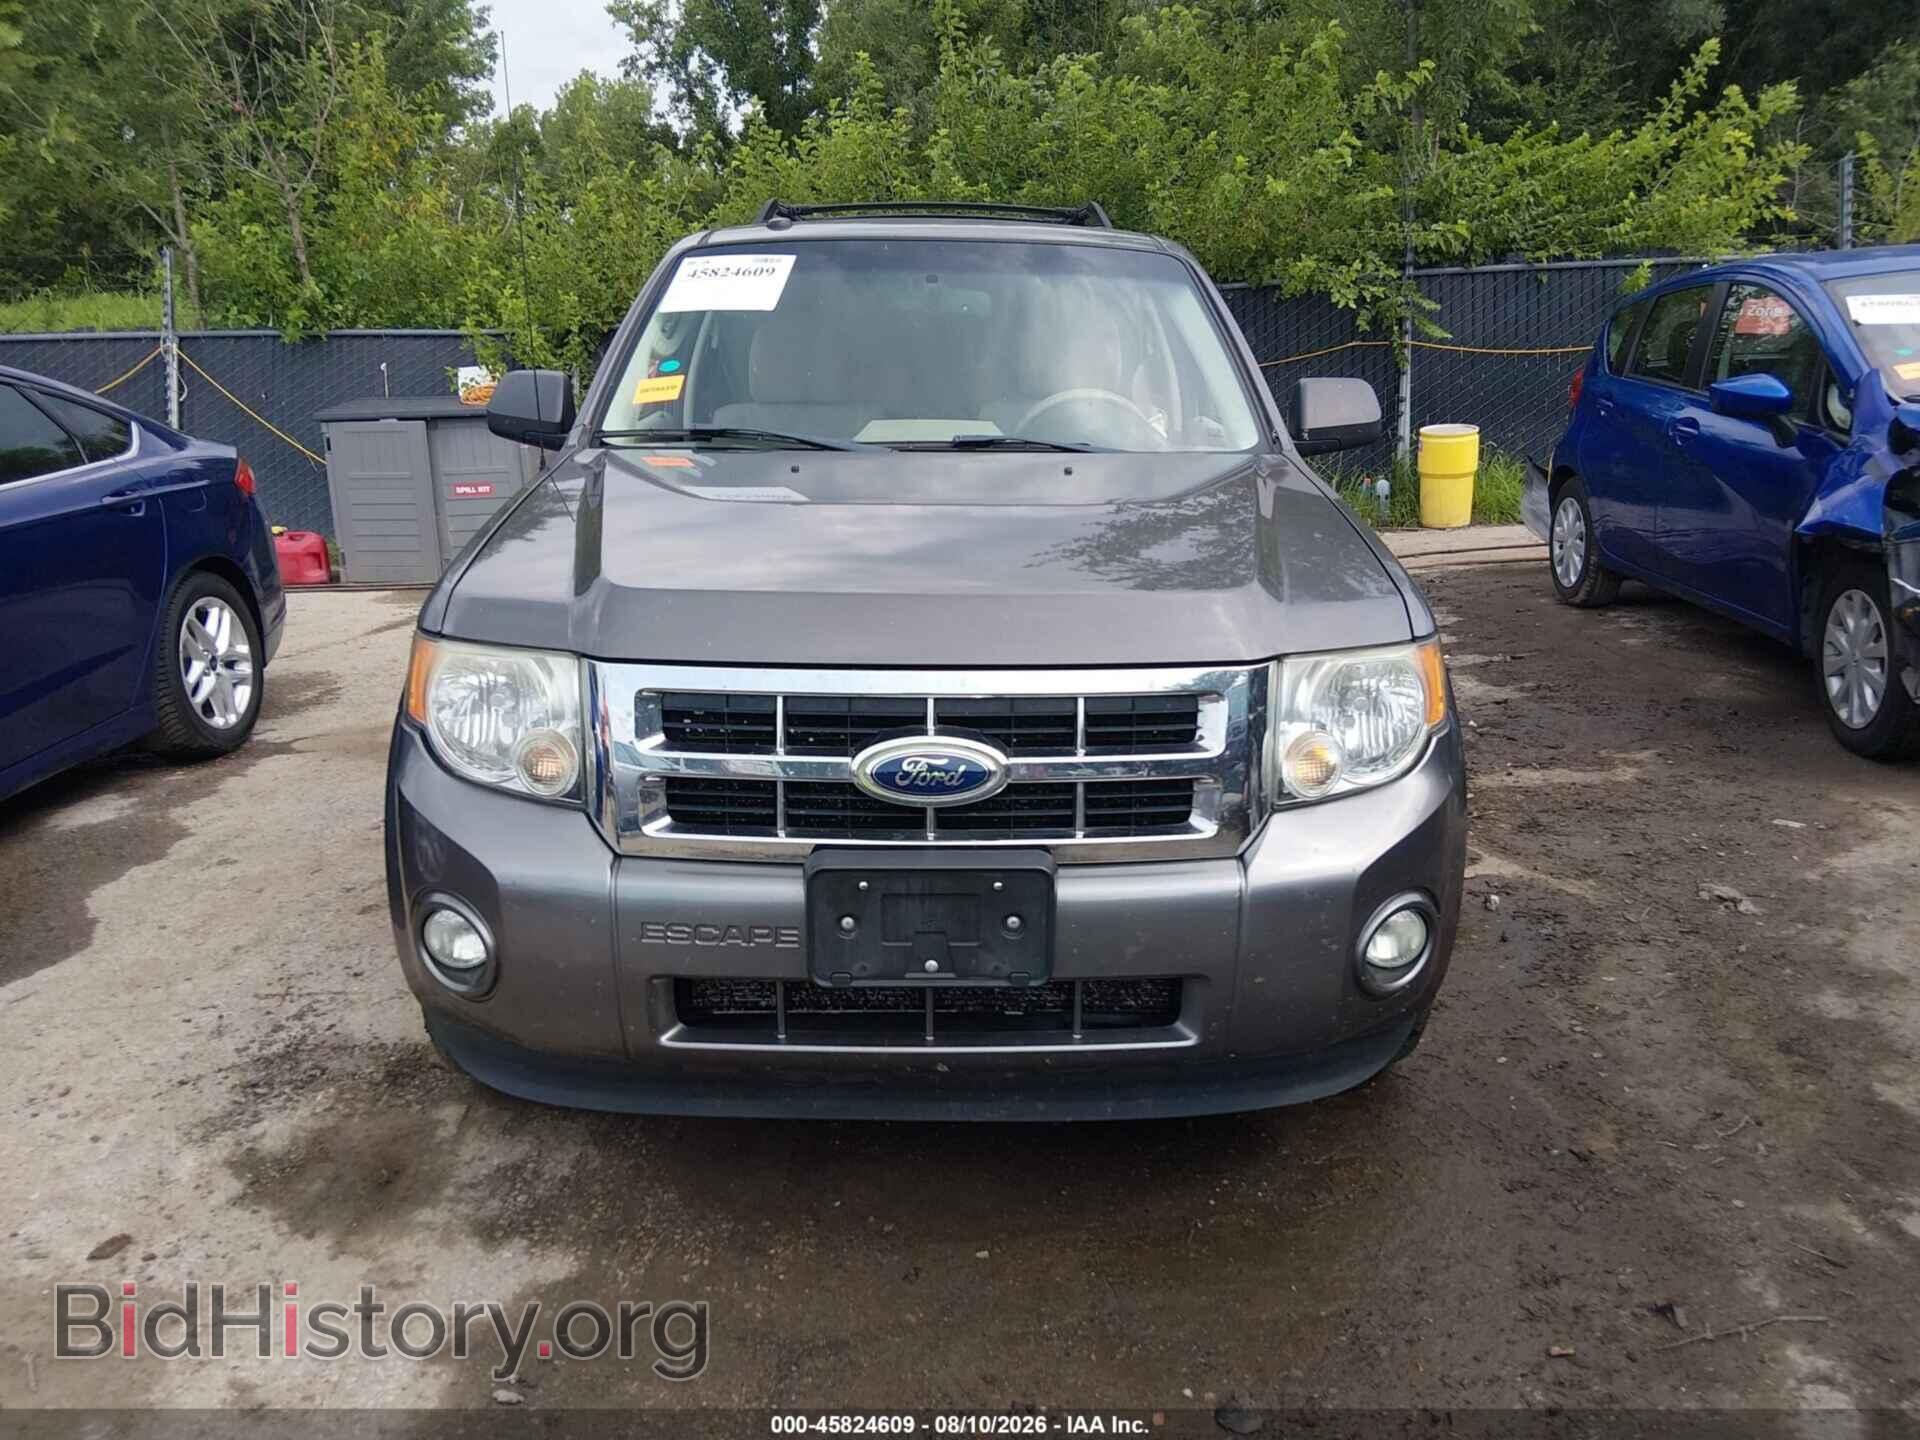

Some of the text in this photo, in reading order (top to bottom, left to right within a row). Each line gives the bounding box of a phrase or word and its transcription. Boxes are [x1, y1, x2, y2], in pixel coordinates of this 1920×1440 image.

[687, 266, 776, 279] 45824609
[456, 486, 476, 494] SPILL
[895, 756, 966, 787] Ford
[640, 921, 800, 948] ESCAPE
